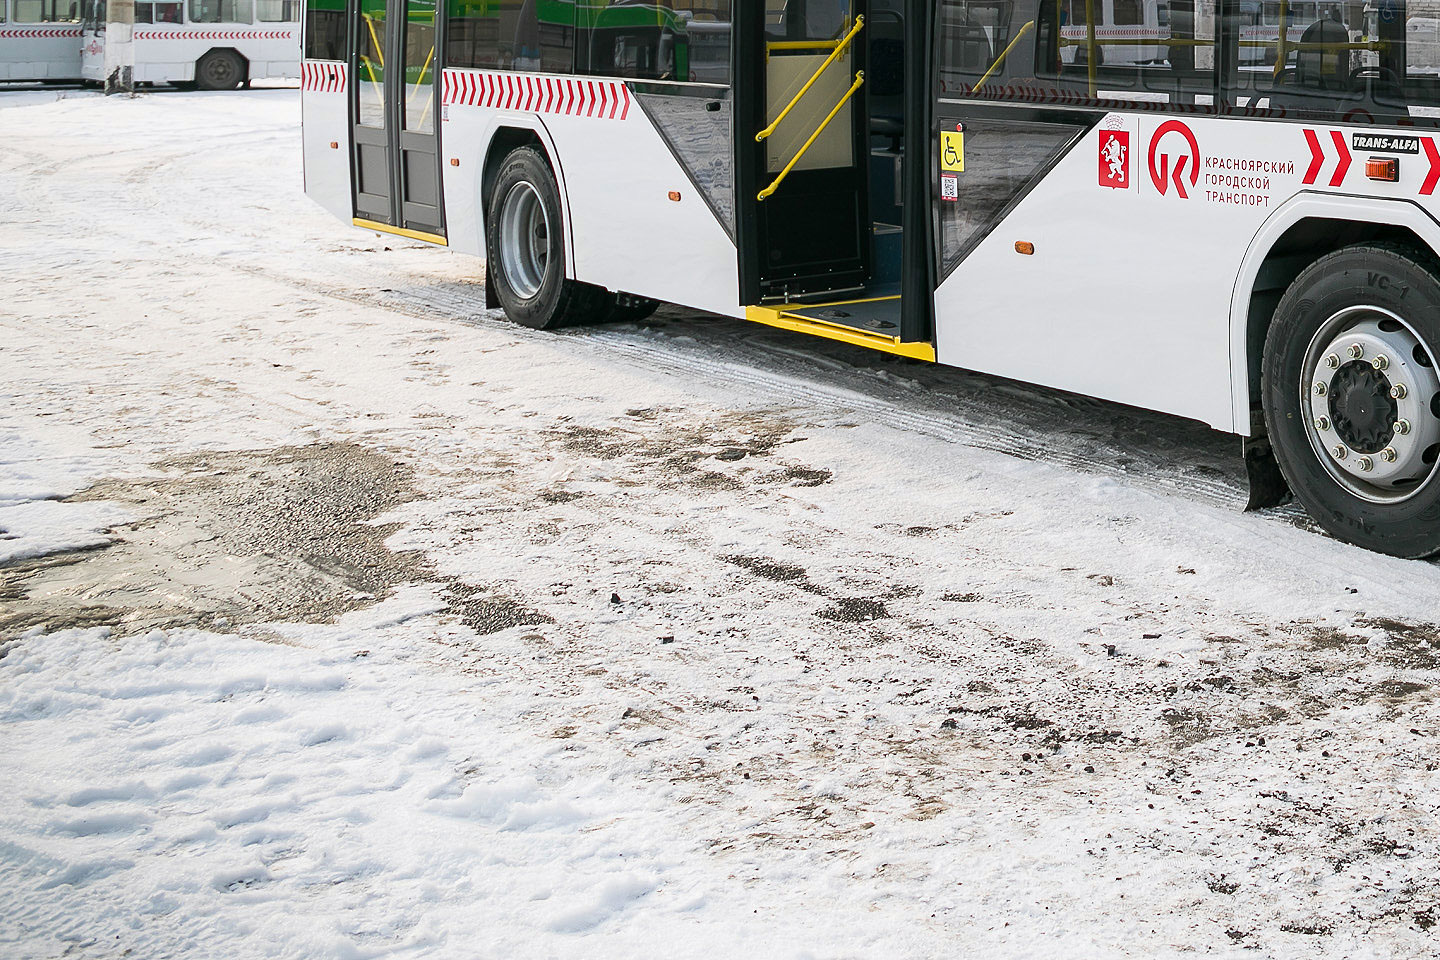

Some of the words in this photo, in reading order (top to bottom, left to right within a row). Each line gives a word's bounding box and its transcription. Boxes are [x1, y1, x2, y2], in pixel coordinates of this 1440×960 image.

[1353, 136, 1418, 151] TRANS-ALFA
[1205, 156, 1294, 175] КРАСНОЯРСКИЙ
[1205, 174, 1270, 190] ГОРОДСКОЙ
[1205, 190, 1270, 207] ТРАНСПОРТ
[1367, 271, 1410, 300] VC-1
